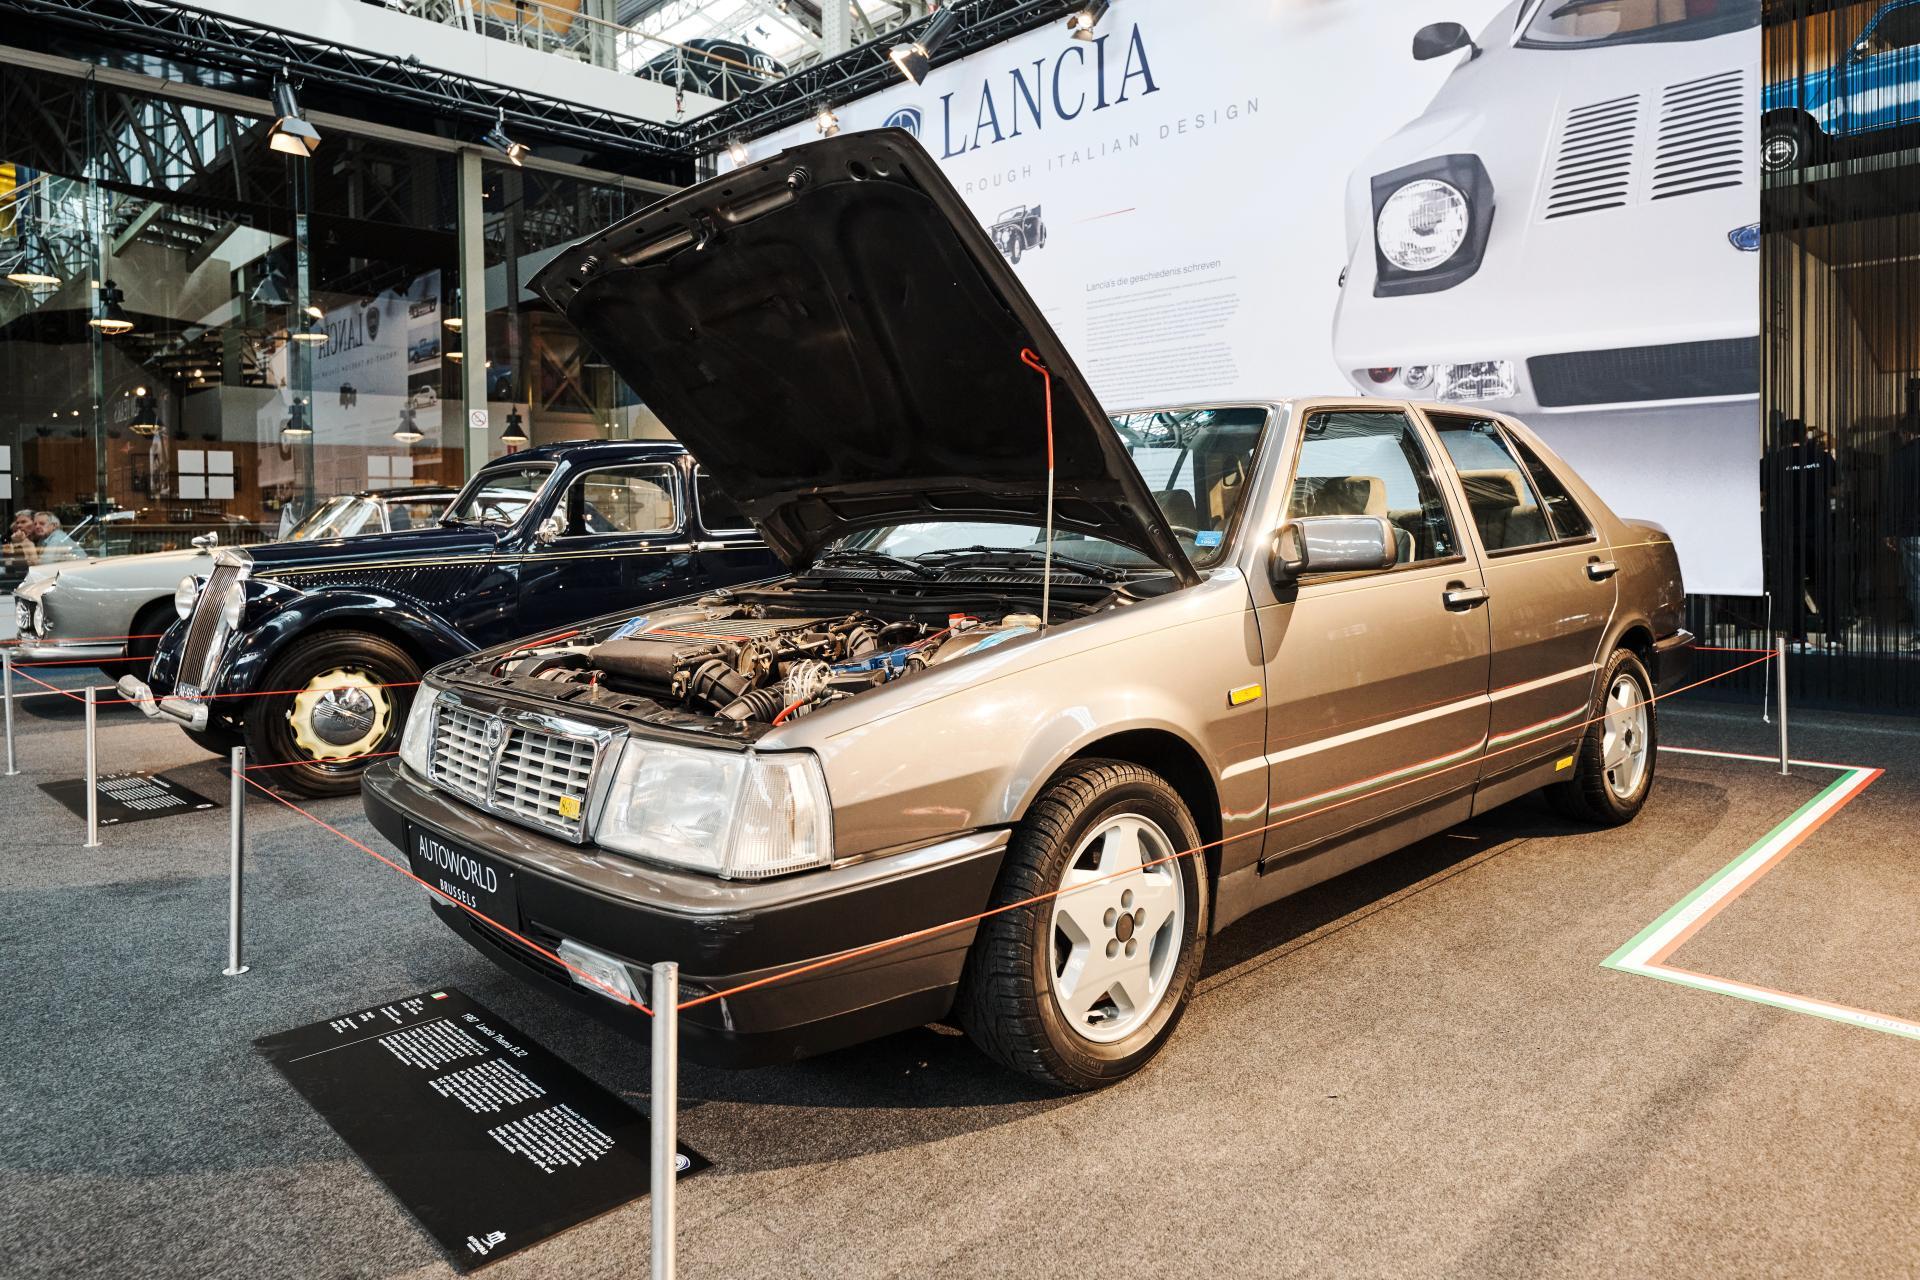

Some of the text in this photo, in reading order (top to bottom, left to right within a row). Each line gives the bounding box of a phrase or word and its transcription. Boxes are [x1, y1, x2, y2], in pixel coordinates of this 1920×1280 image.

[940, 23, 1159, 160] LANCIA
[957, 97, 1260, 195] ROUGH ITALIAN DESIGN
[419, 834, 497, 893] AUTOWORLD
[439, 878, 477, 908] BRUSSELS
